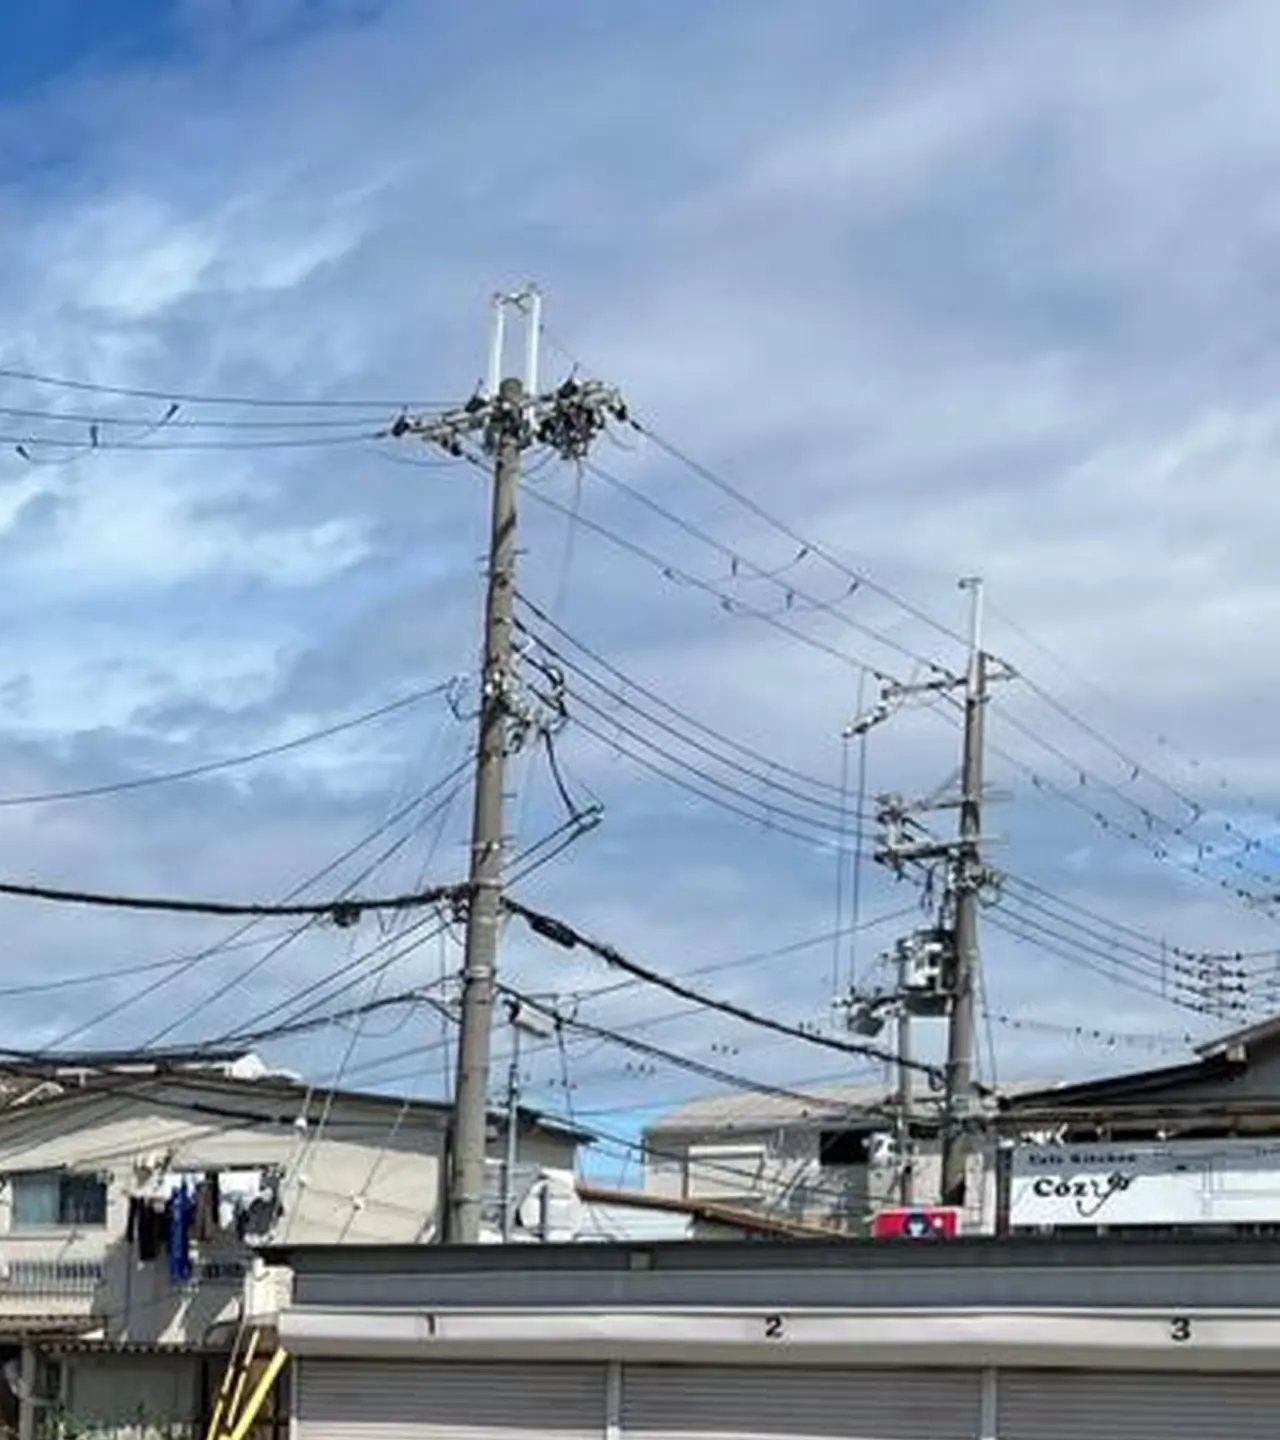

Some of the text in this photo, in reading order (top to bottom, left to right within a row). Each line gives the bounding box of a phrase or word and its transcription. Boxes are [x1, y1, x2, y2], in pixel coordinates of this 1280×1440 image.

[426, 1314, 436, 1336] 1
[765, 1314, 783, 1338] 2
[1170, 1316, 1191, 1341] 3
